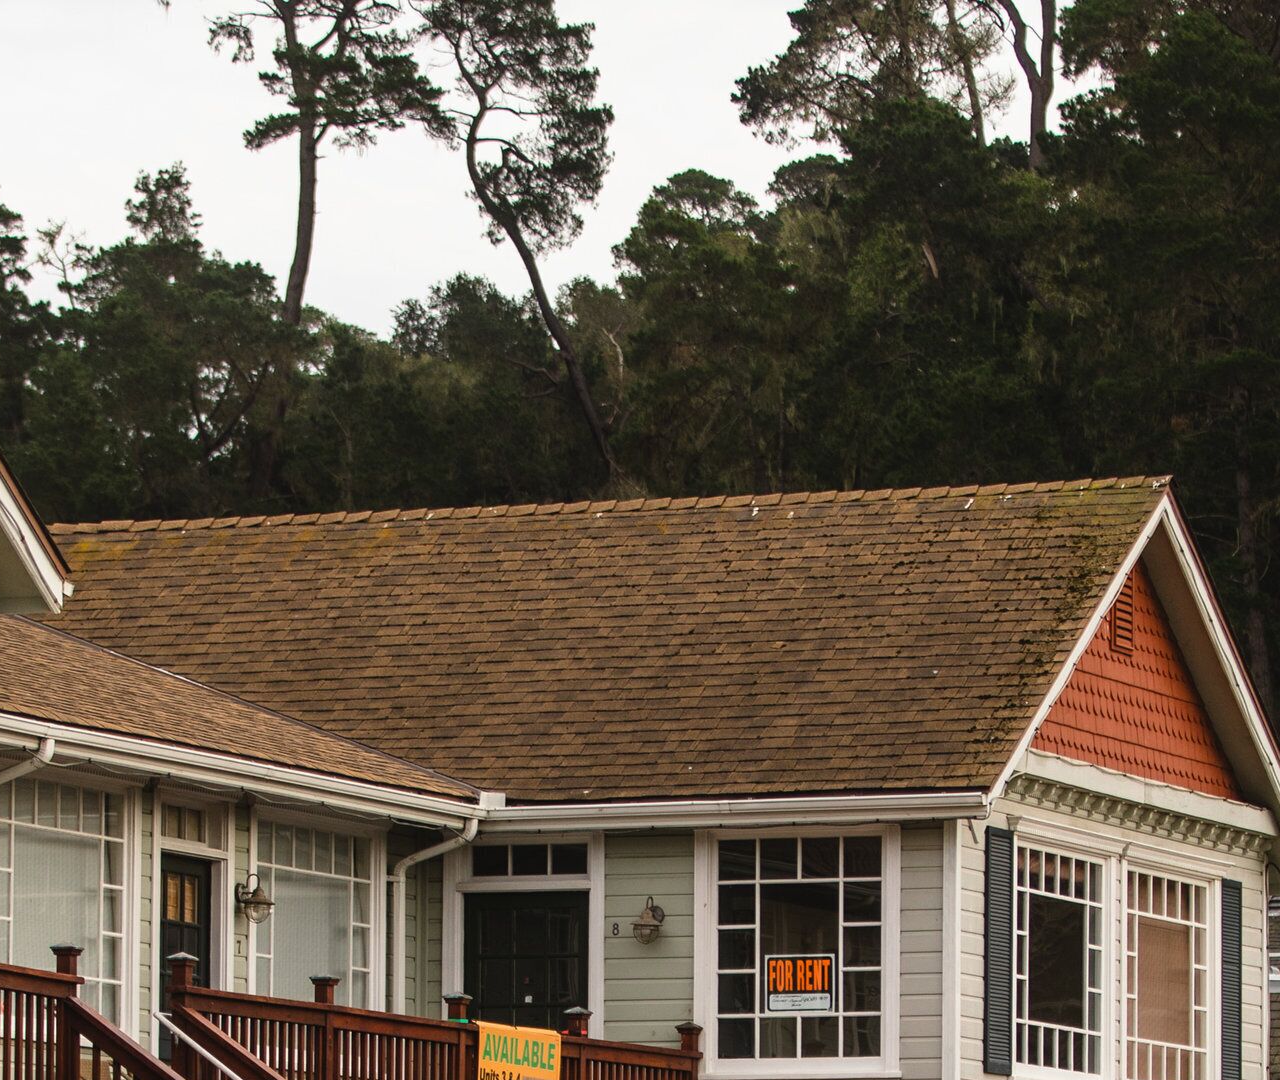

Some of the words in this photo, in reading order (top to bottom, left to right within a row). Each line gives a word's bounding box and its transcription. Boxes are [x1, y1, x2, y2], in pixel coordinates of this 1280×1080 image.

[612, 922, 620, 936] 8
[236, 940, 242, 954] 7
[769, 960, 794, 992] FOR
[797, 959, 831, 991] RENT
[482, 1033, 556, 1071] AVAILABLE
